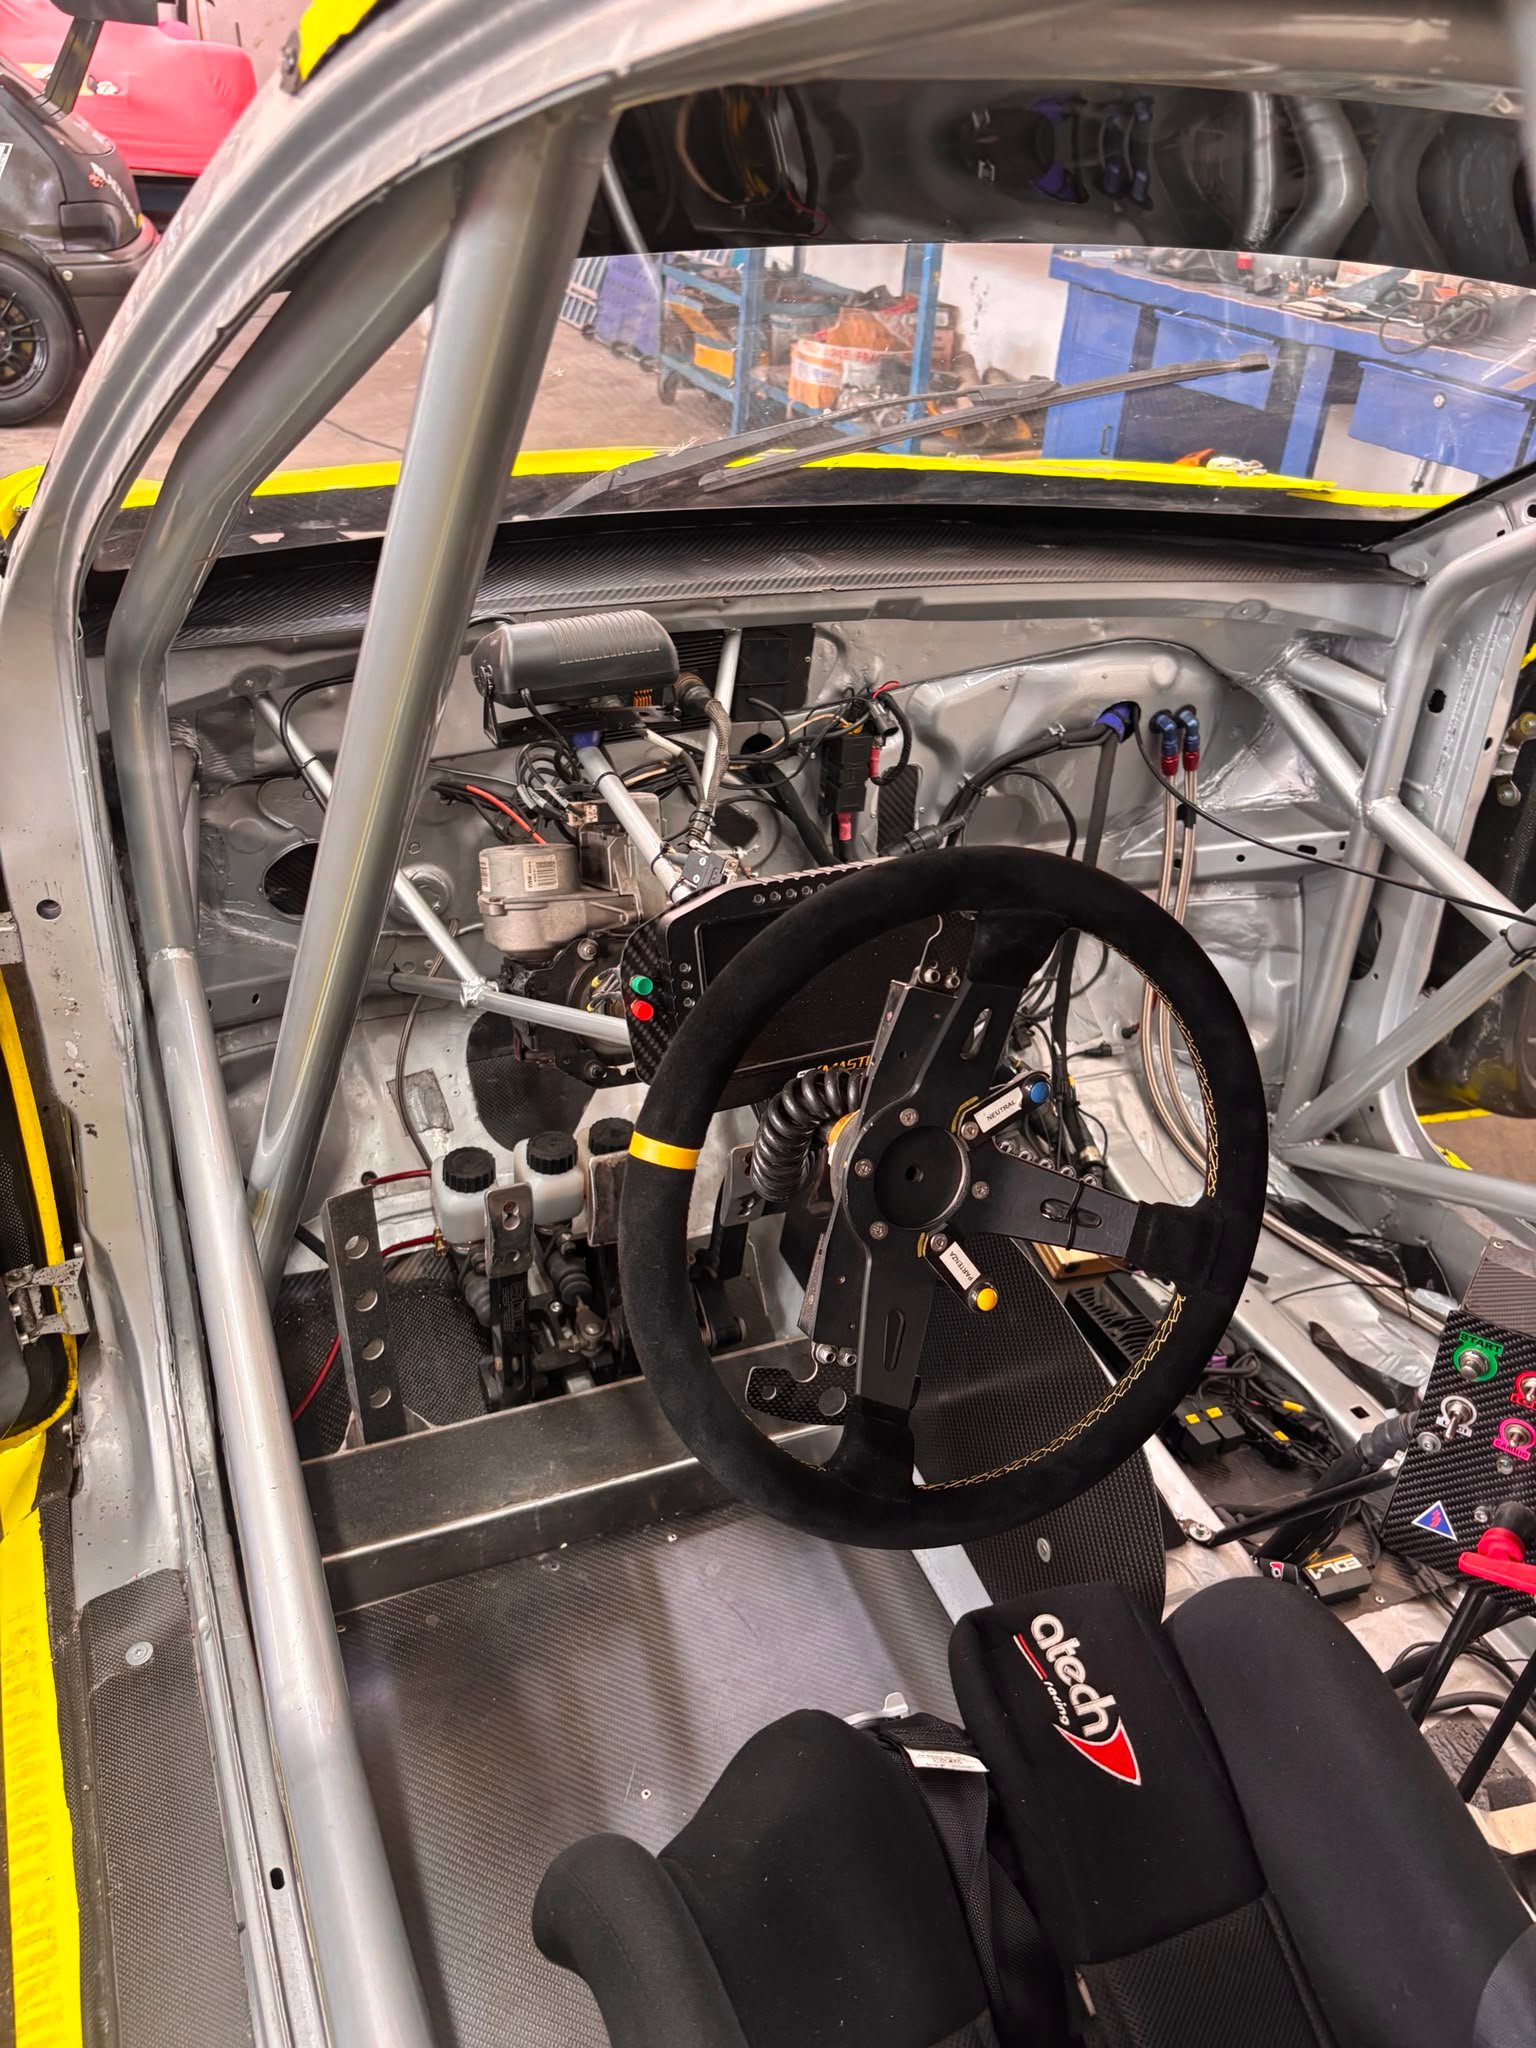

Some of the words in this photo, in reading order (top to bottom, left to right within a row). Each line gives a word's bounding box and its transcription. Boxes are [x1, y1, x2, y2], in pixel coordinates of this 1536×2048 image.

[986, 1100, 1017, 1121] NEUTRAL
[949, 1251, 974, 1281] PARTENZA
[1460, 1333, 1503, 1353] START
[1030, 1613, 1117, 1738] atech
[1043, 1680, 1071, 1727] racing
